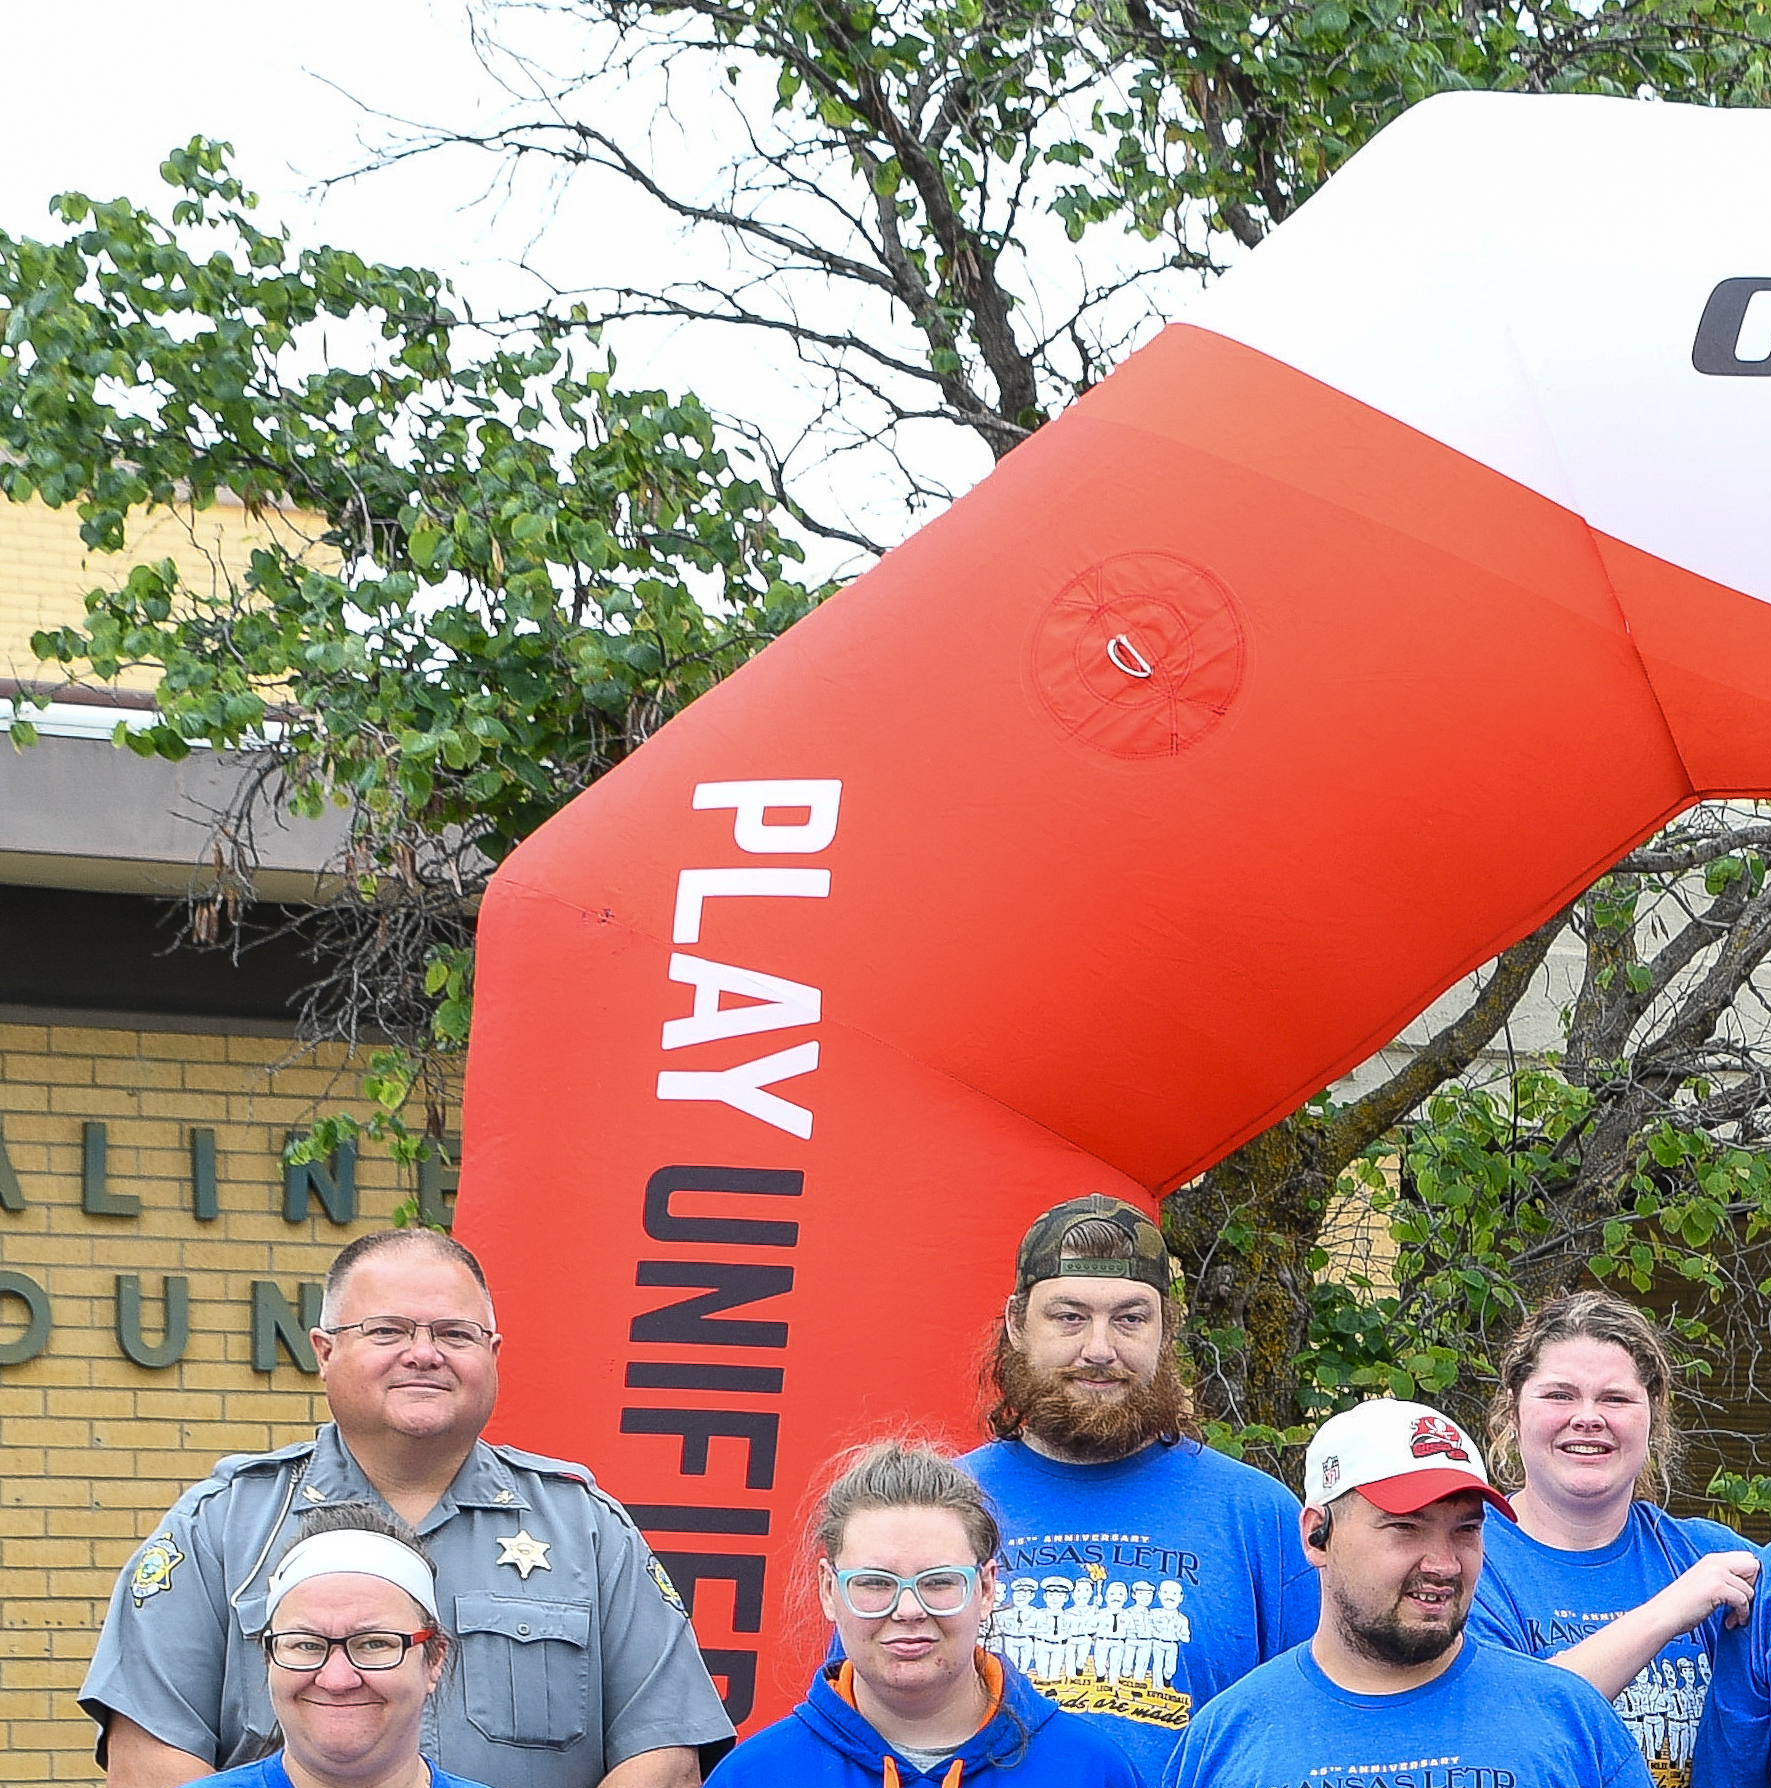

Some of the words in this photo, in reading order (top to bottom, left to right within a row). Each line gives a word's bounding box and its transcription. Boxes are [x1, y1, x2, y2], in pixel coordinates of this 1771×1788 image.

[656, 778, 843, 1141] PLAY
[1043, 1533, 1149, 1545] ANNIVERSARY
[1112, 1546, 1199, 1585] LETR
[1093, 1698, 1130, 1712] are
[1131, 1703, 1189, 1726] made
[1348, 1756, 1461, 1775] ANNIVERSARY
